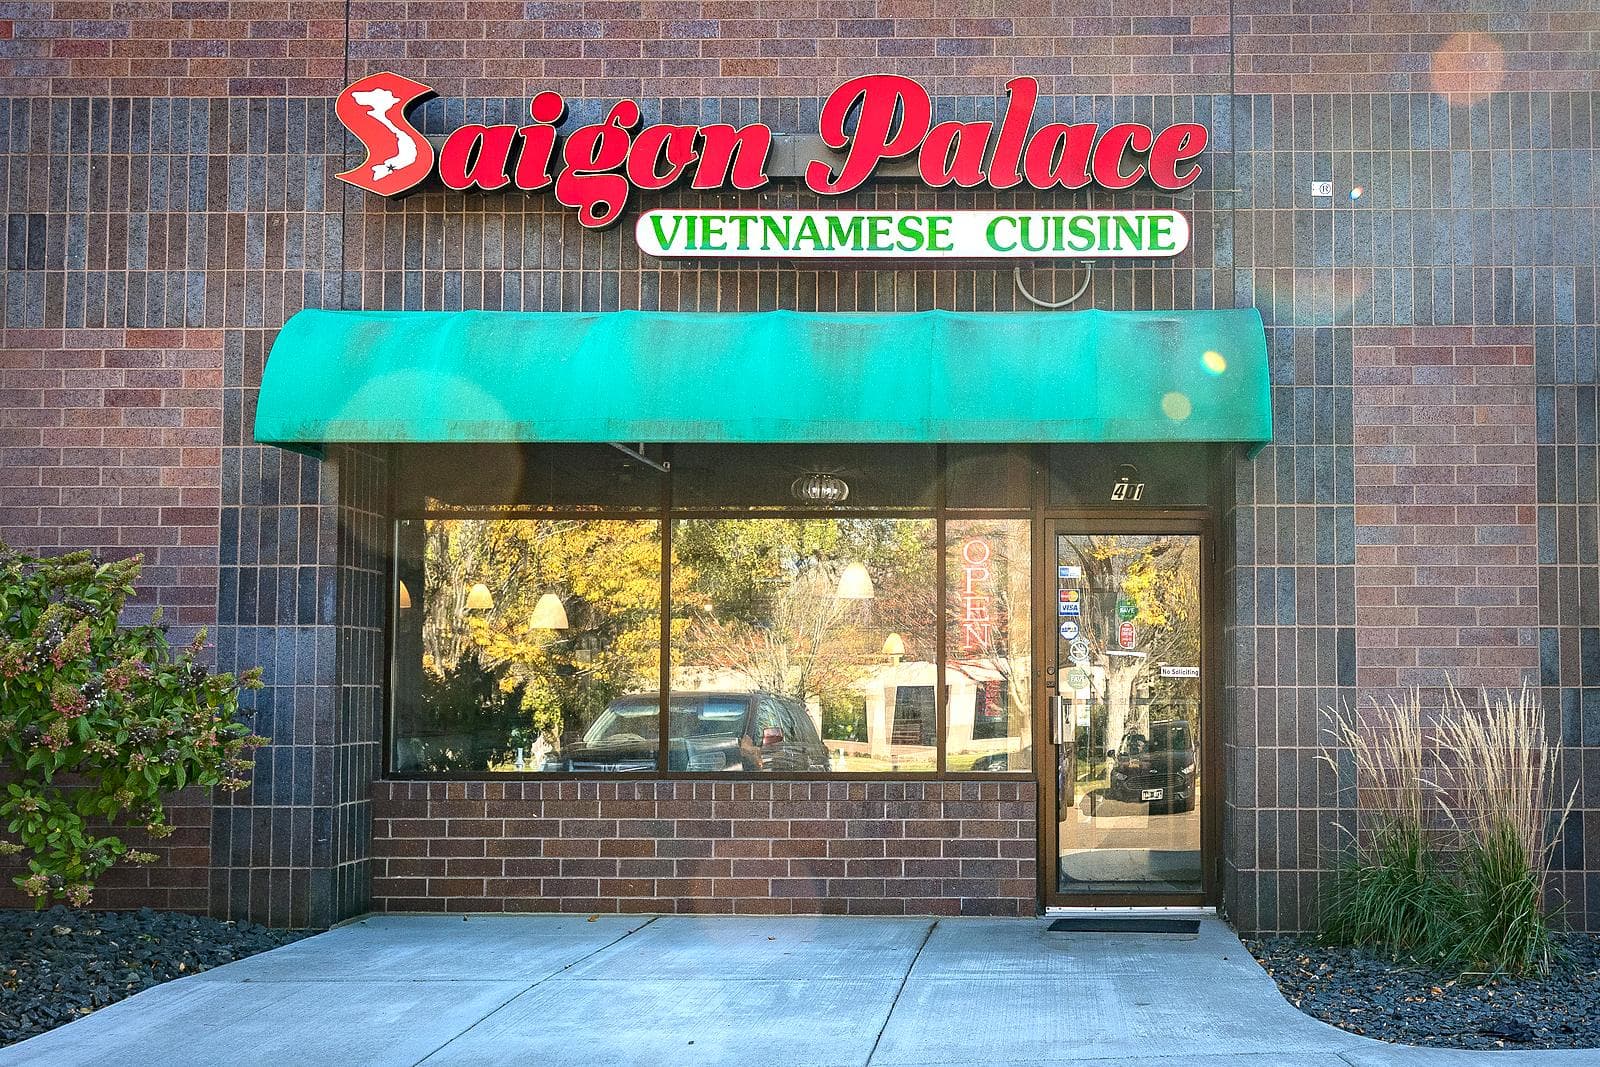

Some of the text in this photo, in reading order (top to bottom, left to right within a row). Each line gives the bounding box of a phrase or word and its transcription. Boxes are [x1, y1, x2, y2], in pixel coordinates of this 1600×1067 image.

[335, 71, 1209, 228] Saigon Palace
[650, 215, 1176, 252] VIETNAMESE CUISINE
[1112, 484, 1144, 500] 401
[964, 539, 991, 649] OPEN
[1171, 668, 1199, 676] Soliciting
